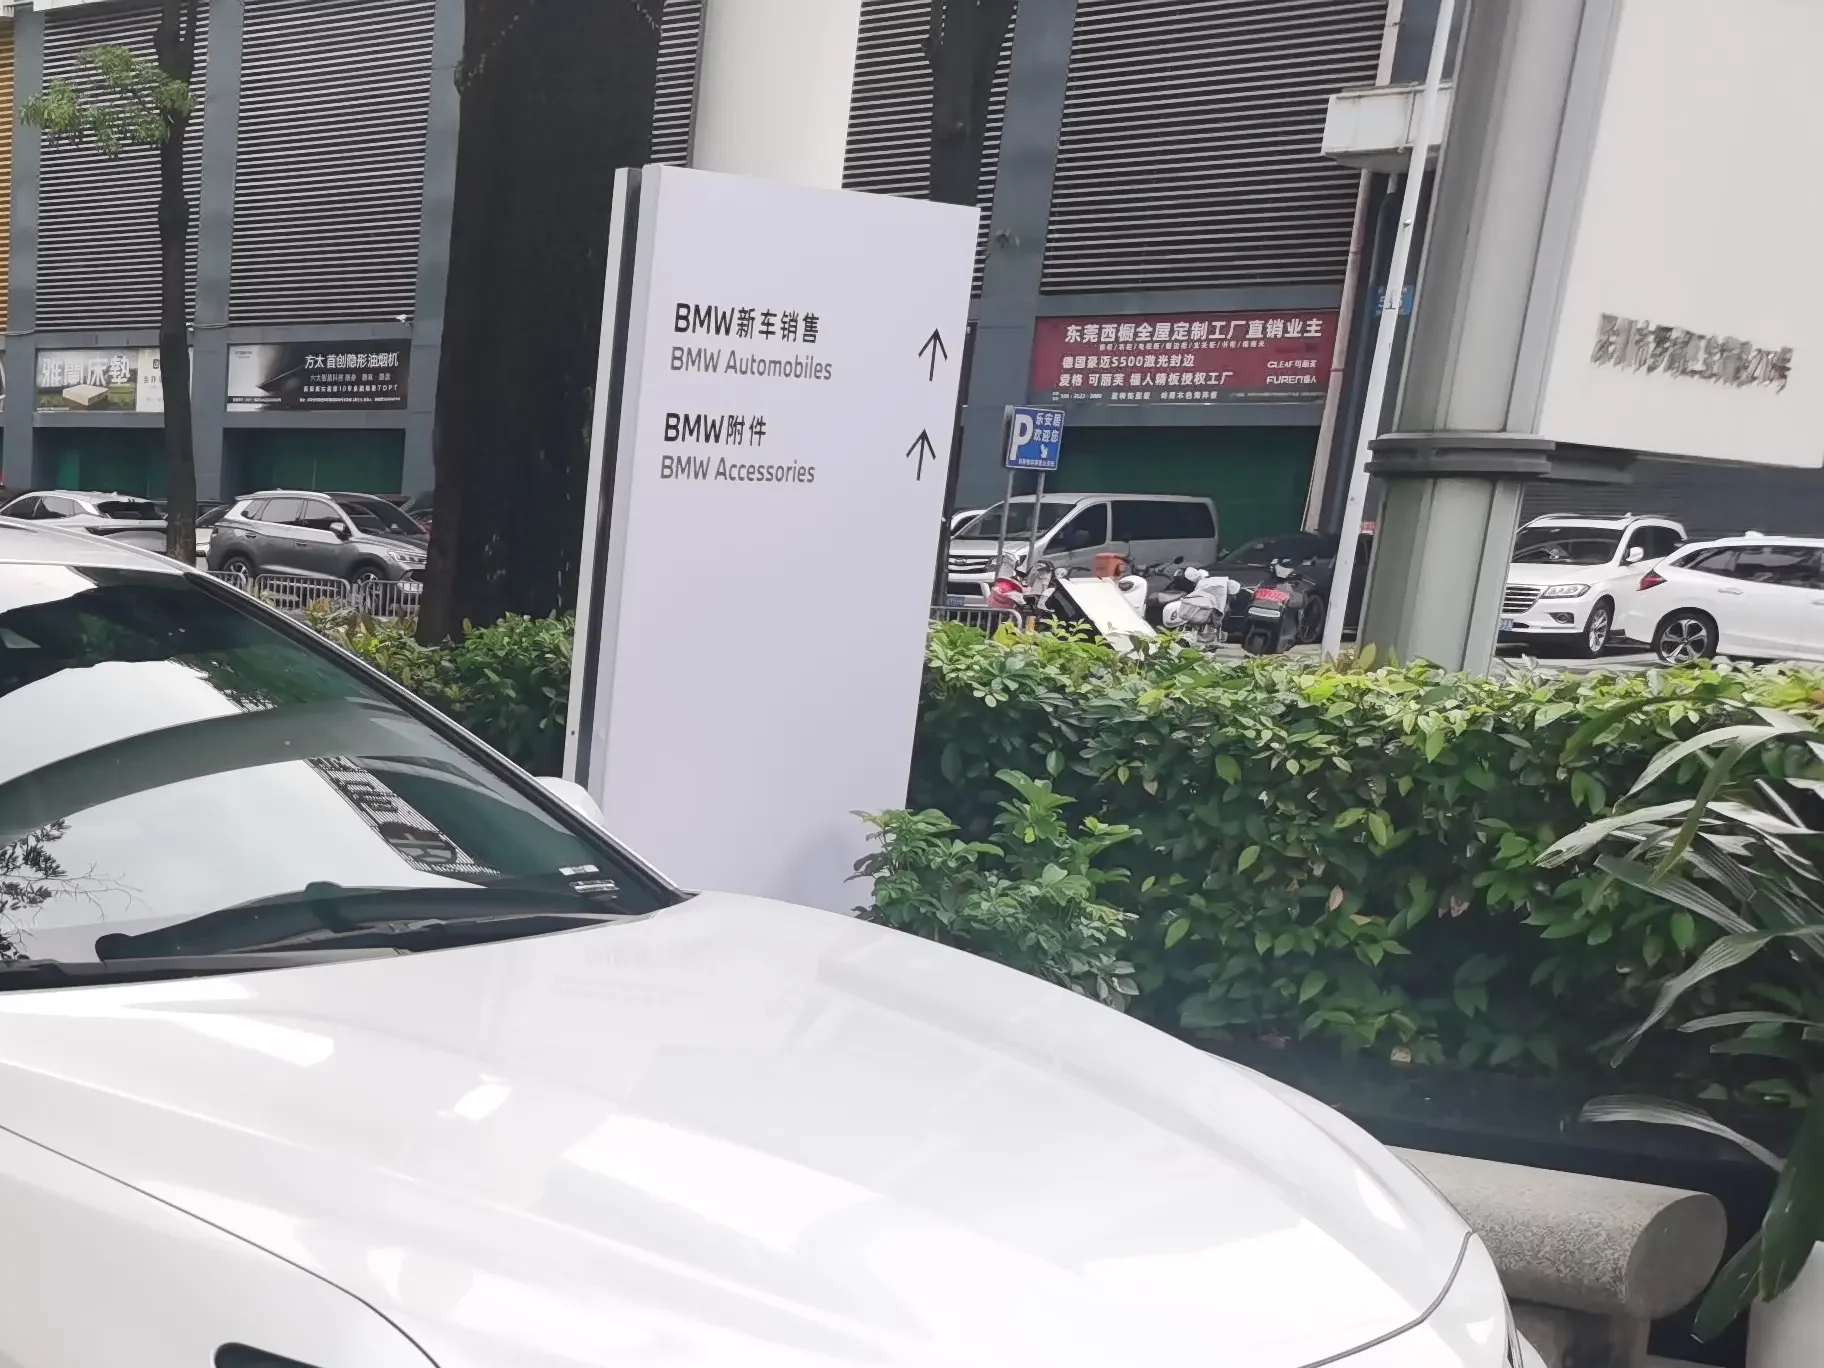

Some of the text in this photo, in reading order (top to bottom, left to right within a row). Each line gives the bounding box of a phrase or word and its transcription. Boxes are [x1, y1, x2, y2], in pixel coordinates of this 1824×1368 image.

[673, 303, 820, 344] BMW新车销售
[1064, 318, 1323, 343] 东莞西橱全屋定制工厂直销业主
[670, 346, 832, 381] BMW Automobiles
[1062, 354, 1195, 369] 德国豪迈S500激光封边
[1088, 373, 1125, 387] 可丽芙
[663, 412, 767, 447] BMW附件
[1009, 413, 1034, 461] P
[660, 455, 815, 484] BMW Accessories
